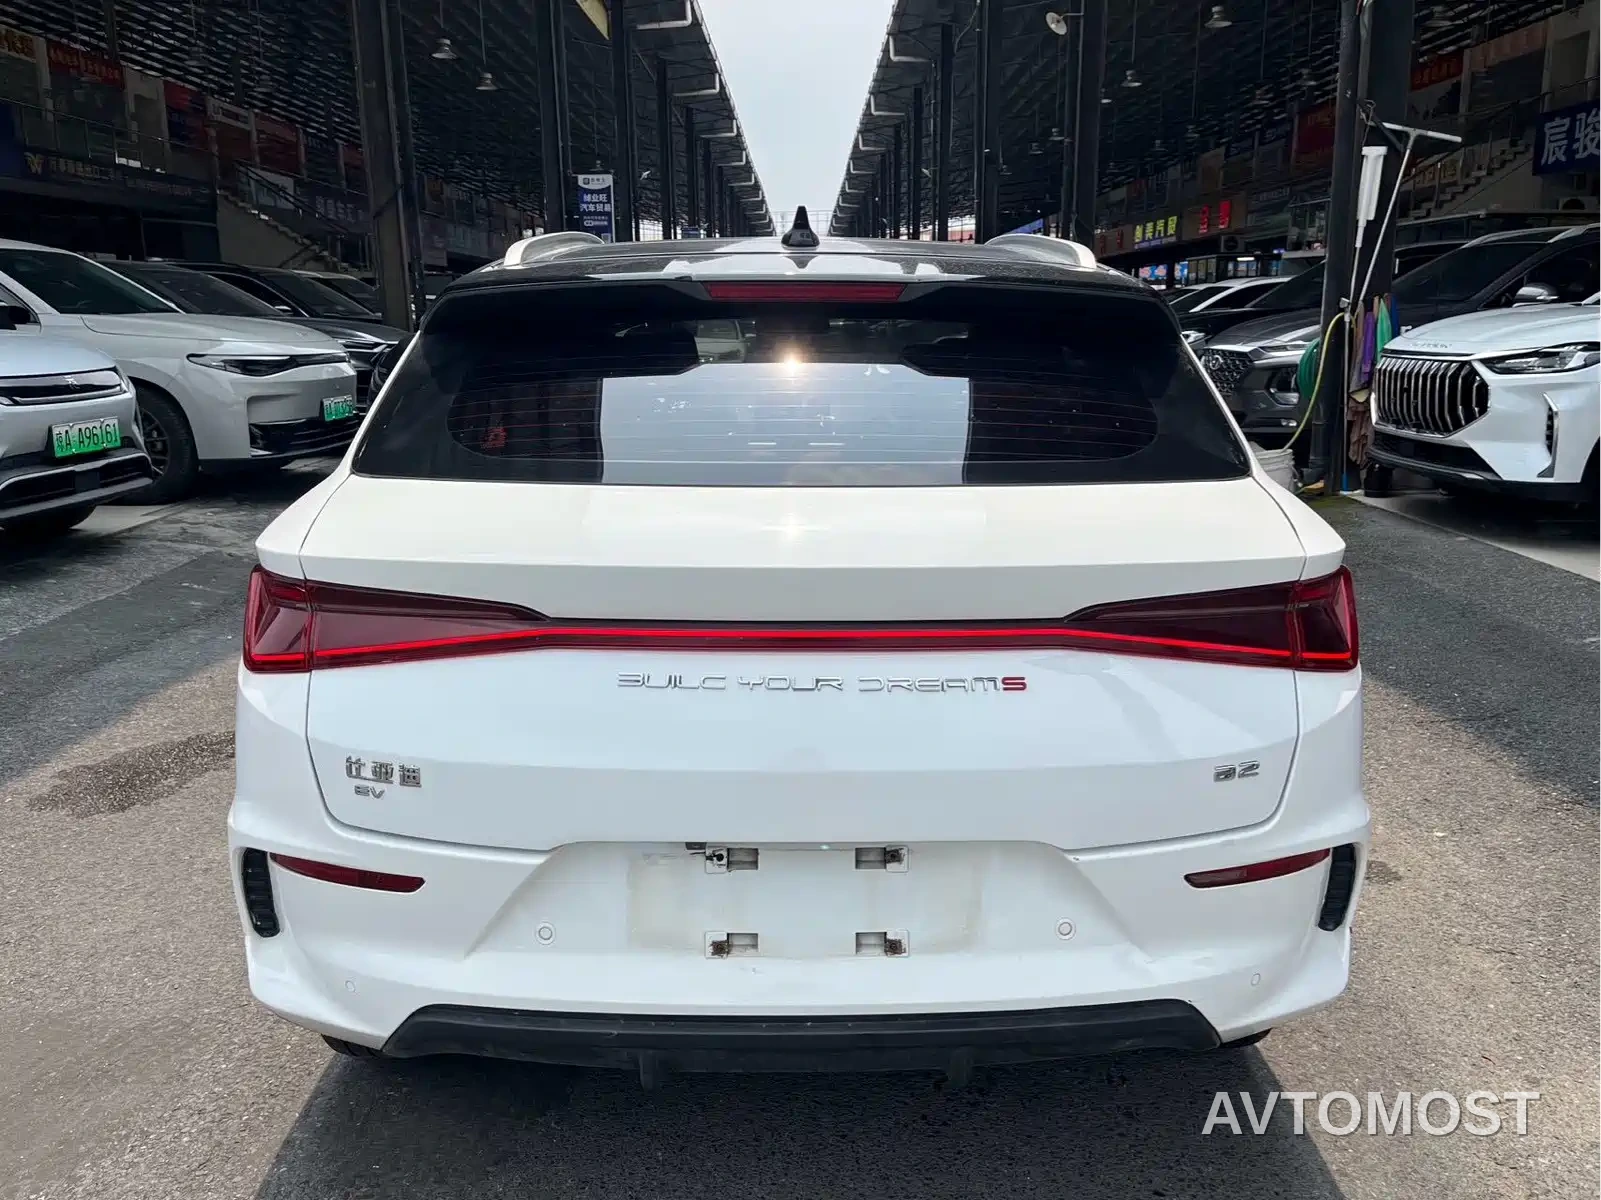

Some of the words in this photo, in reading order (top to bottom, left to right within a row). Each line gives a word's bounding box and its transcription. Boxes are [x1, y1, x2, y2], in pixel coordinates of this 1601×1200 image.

[738, 675, 844, 691] YOUR
[857, 676, 1027, 692] DREAMS
[353, 784, 385, 799] EV
